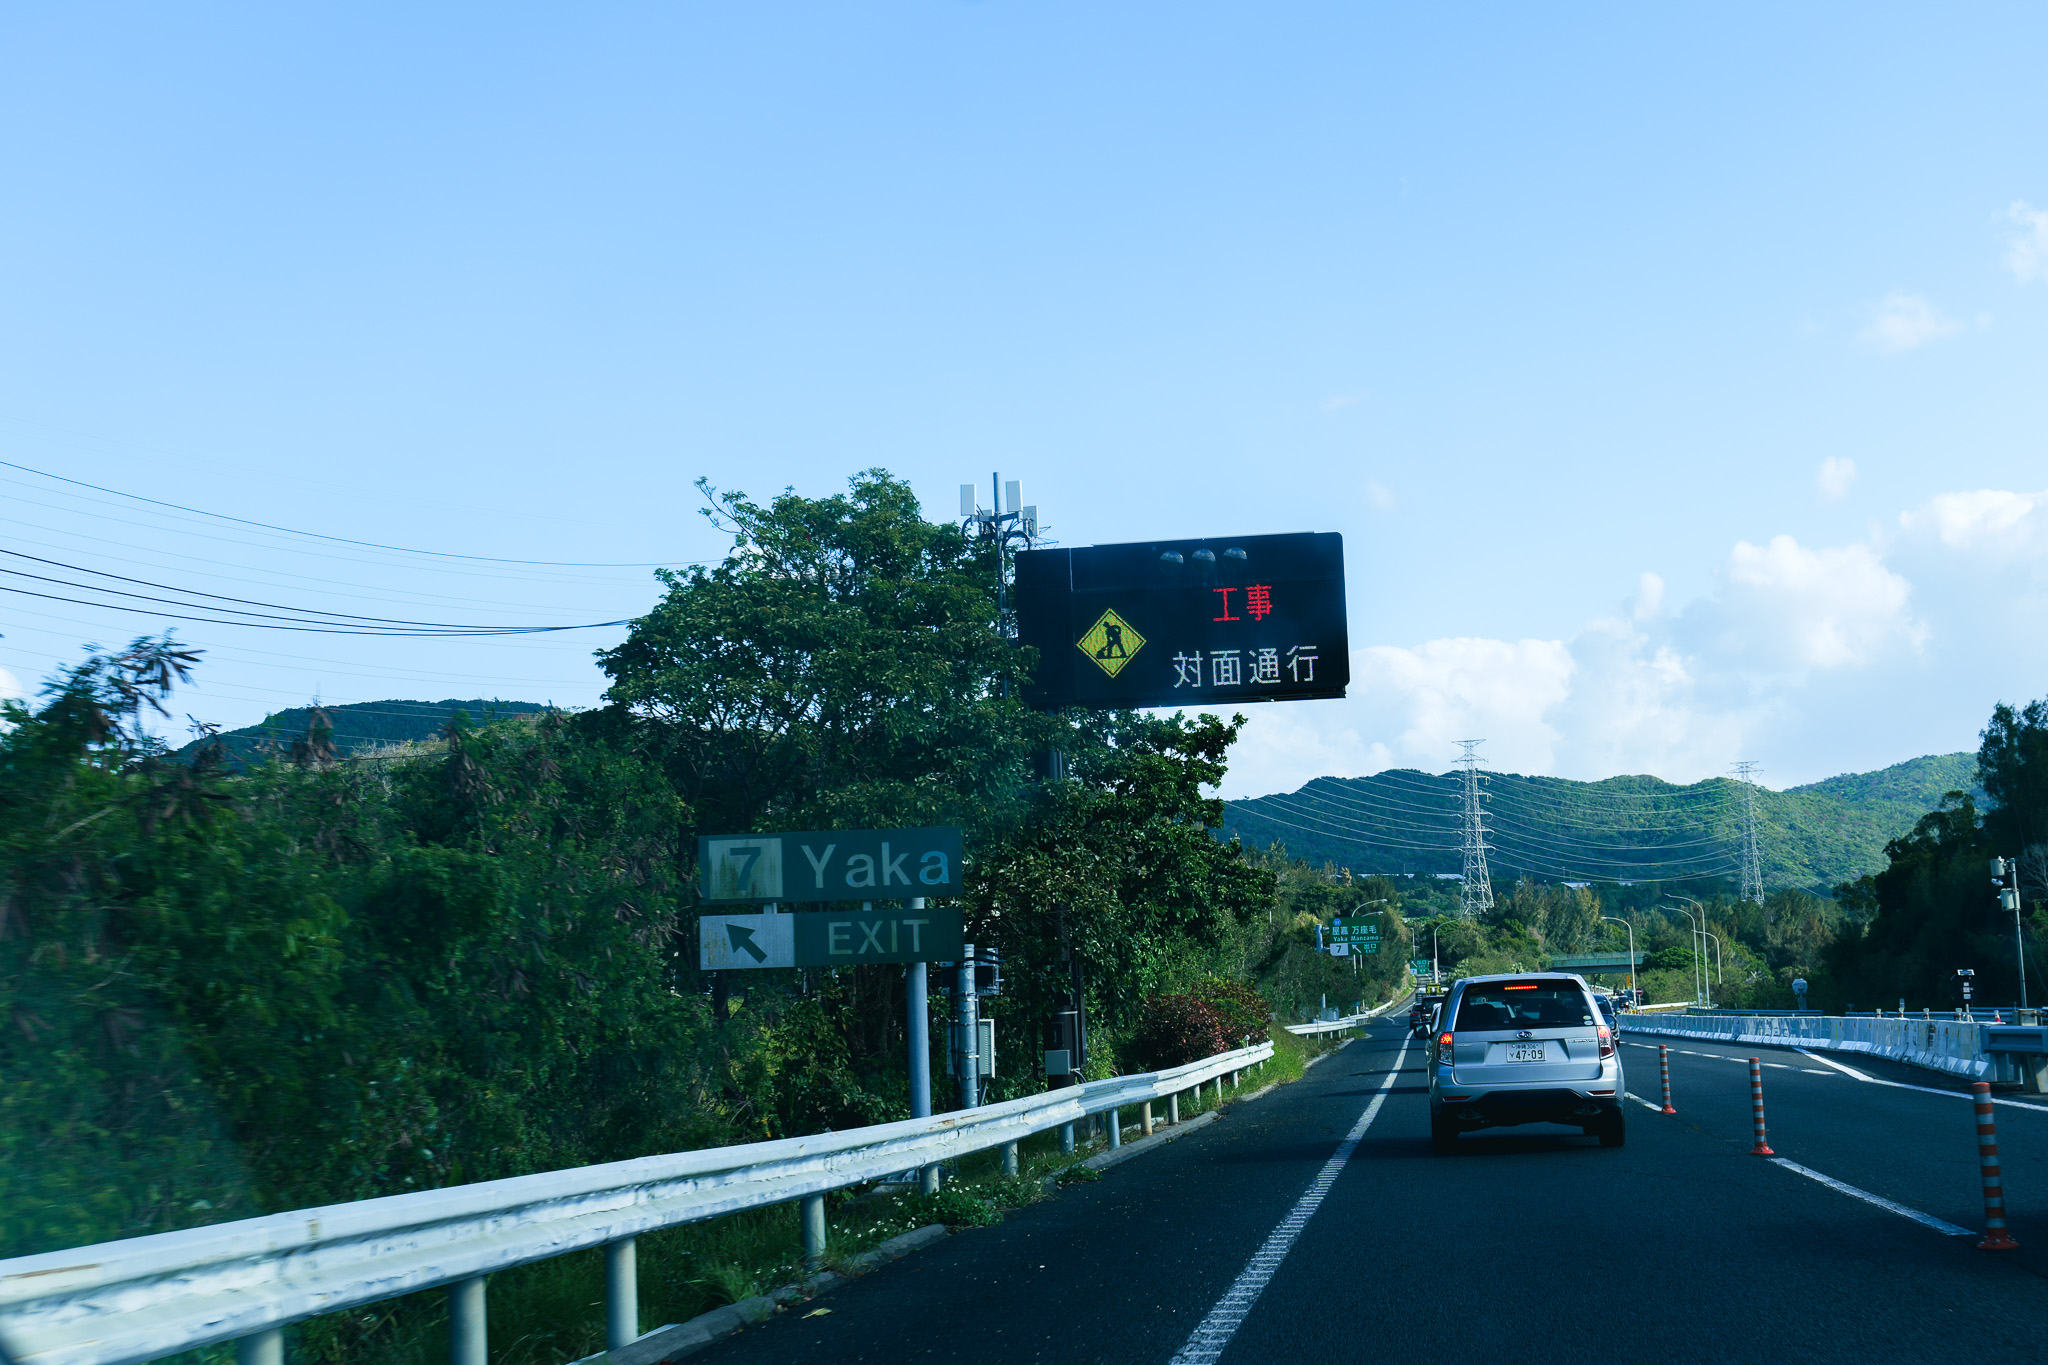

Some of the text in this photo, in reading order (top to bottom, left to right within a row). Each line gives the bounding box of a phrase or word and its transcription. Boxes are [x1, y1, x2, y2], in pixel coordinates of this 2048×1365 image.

[1212, 583, 1273, 621] 工事
[1172, 645, 1319, 688] 対面通行
[728, 842, 950, 894] 7 Yaka
[828, 918, 930, 955] EXIT
[1352, 925, 1377, 935] 万座毛
[1336, 945, 1342, 953] 7
[1516, 1049, 1543, 1060] 47-09
